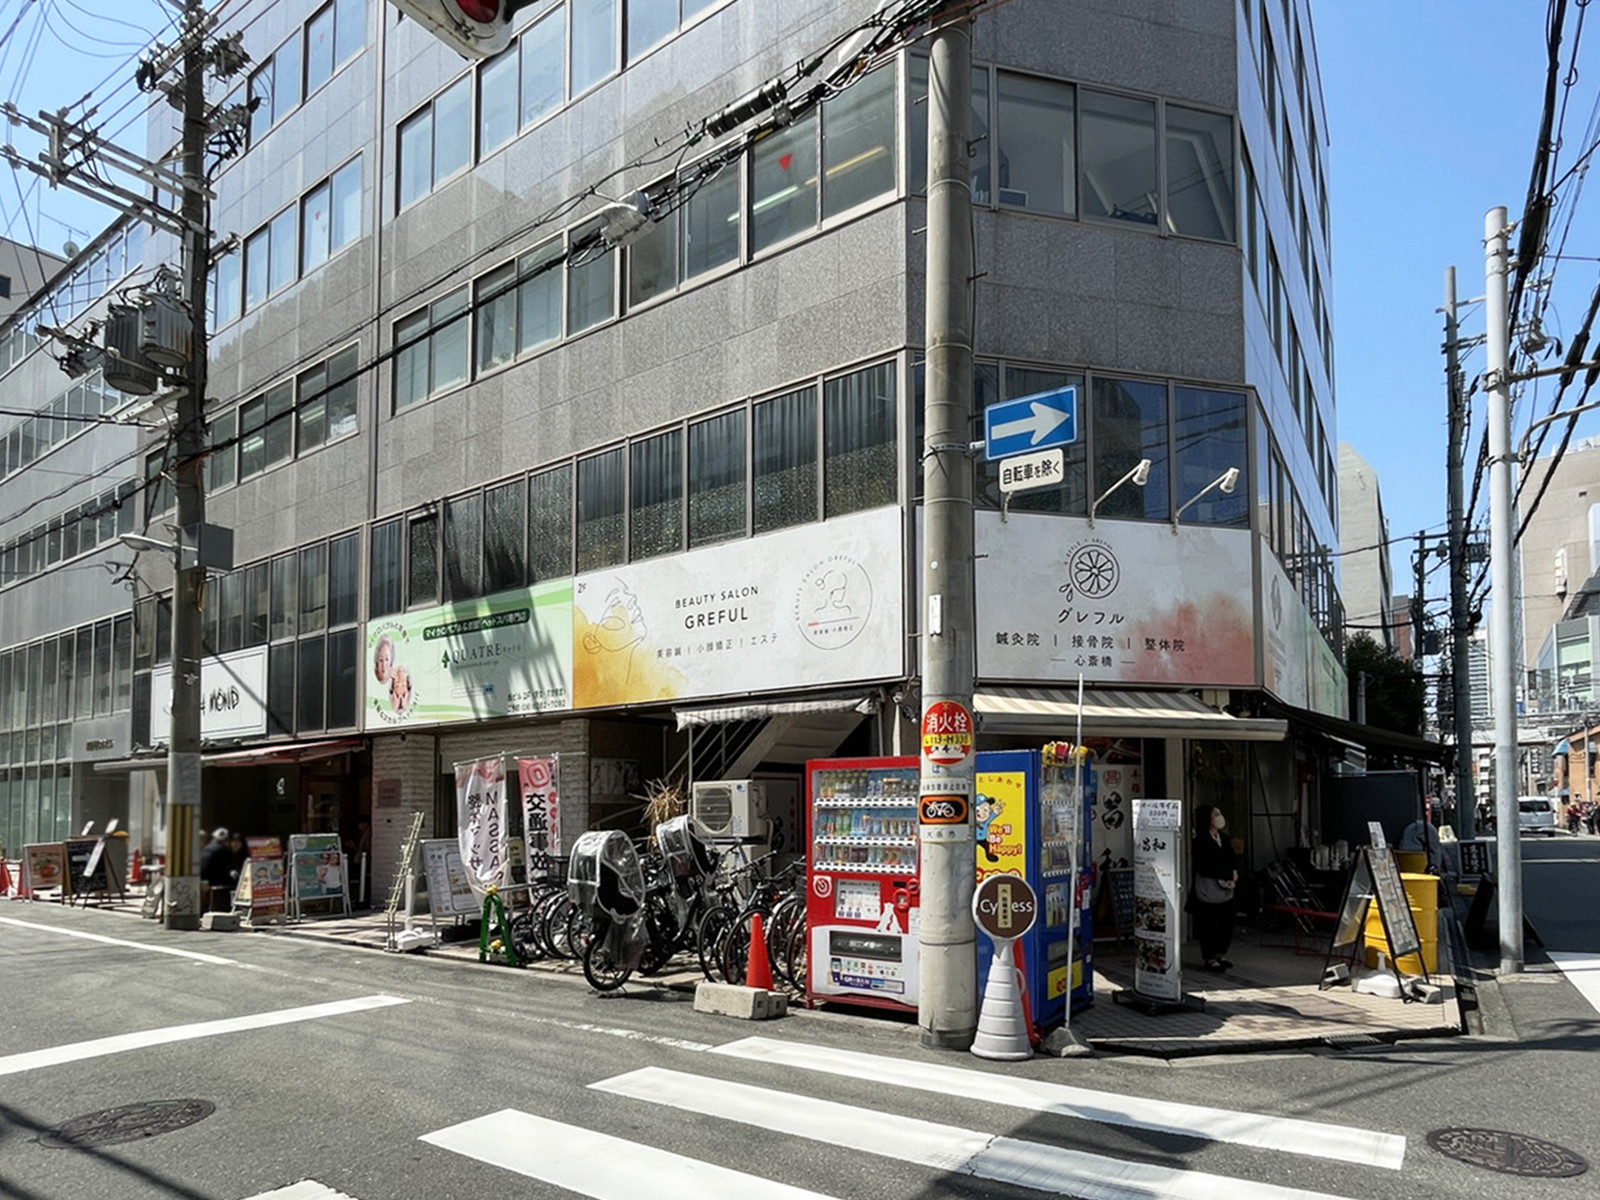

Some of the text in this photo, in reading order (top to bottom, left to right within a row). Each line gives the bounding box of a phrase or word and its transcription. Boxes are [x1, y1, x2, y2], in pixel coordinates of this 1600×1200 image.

[1003, 459, 1060, 485] 自転車を除く
[675, 585, 759, 609] BEAUTY SALON
[684, 607, 748, 630] GREFUL
[1058, 607, 1124, 626] グレフル
[749, 632, 779, 646] エステ
[1072, 634, 1114, 649] 接骨院
[1144, 637, 1186, 652] 整体院
[452, 643, 501, 664] QUATRE
[926, 712, 968, 733] 消火栓
[988, 824, 1012, 836] We'll
[988, 834, 1003, 845] Be
[988, 843, 1023, 857] Happy!
[980, 899, 1033, 915] Cyess
